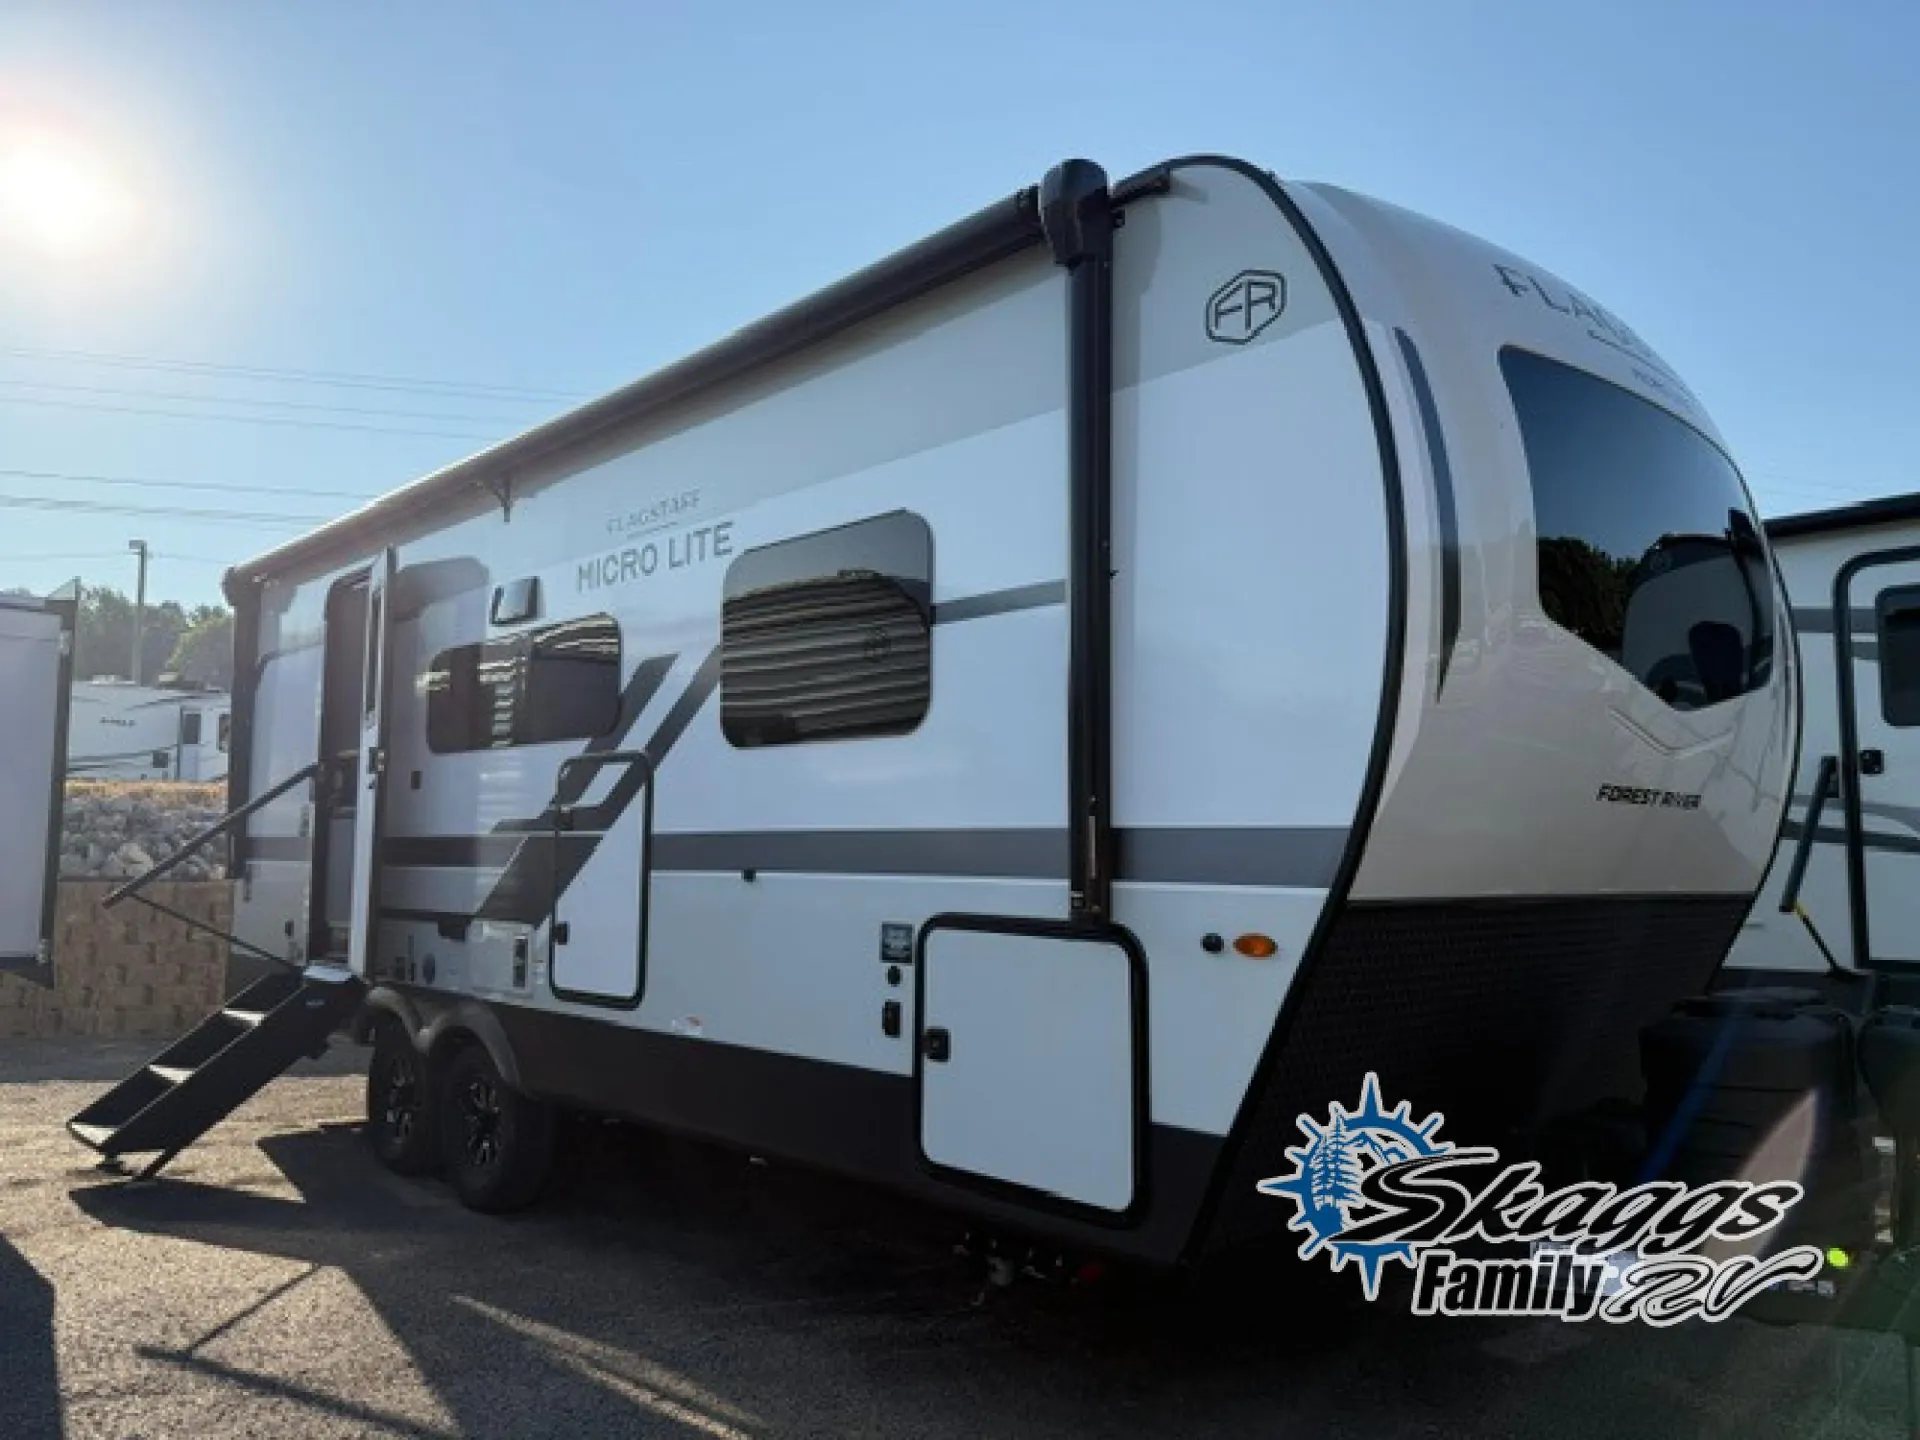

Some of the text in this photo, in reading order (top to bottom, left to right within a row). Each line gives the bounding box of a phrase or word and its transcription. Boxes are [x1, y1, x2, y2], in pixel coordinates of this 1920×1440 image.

[606, 487, 701, 534] FLAGSTAFF
[577, 519, 734, 593] MICRO LITE
[1595, 783, 1661, 806] FOREST
